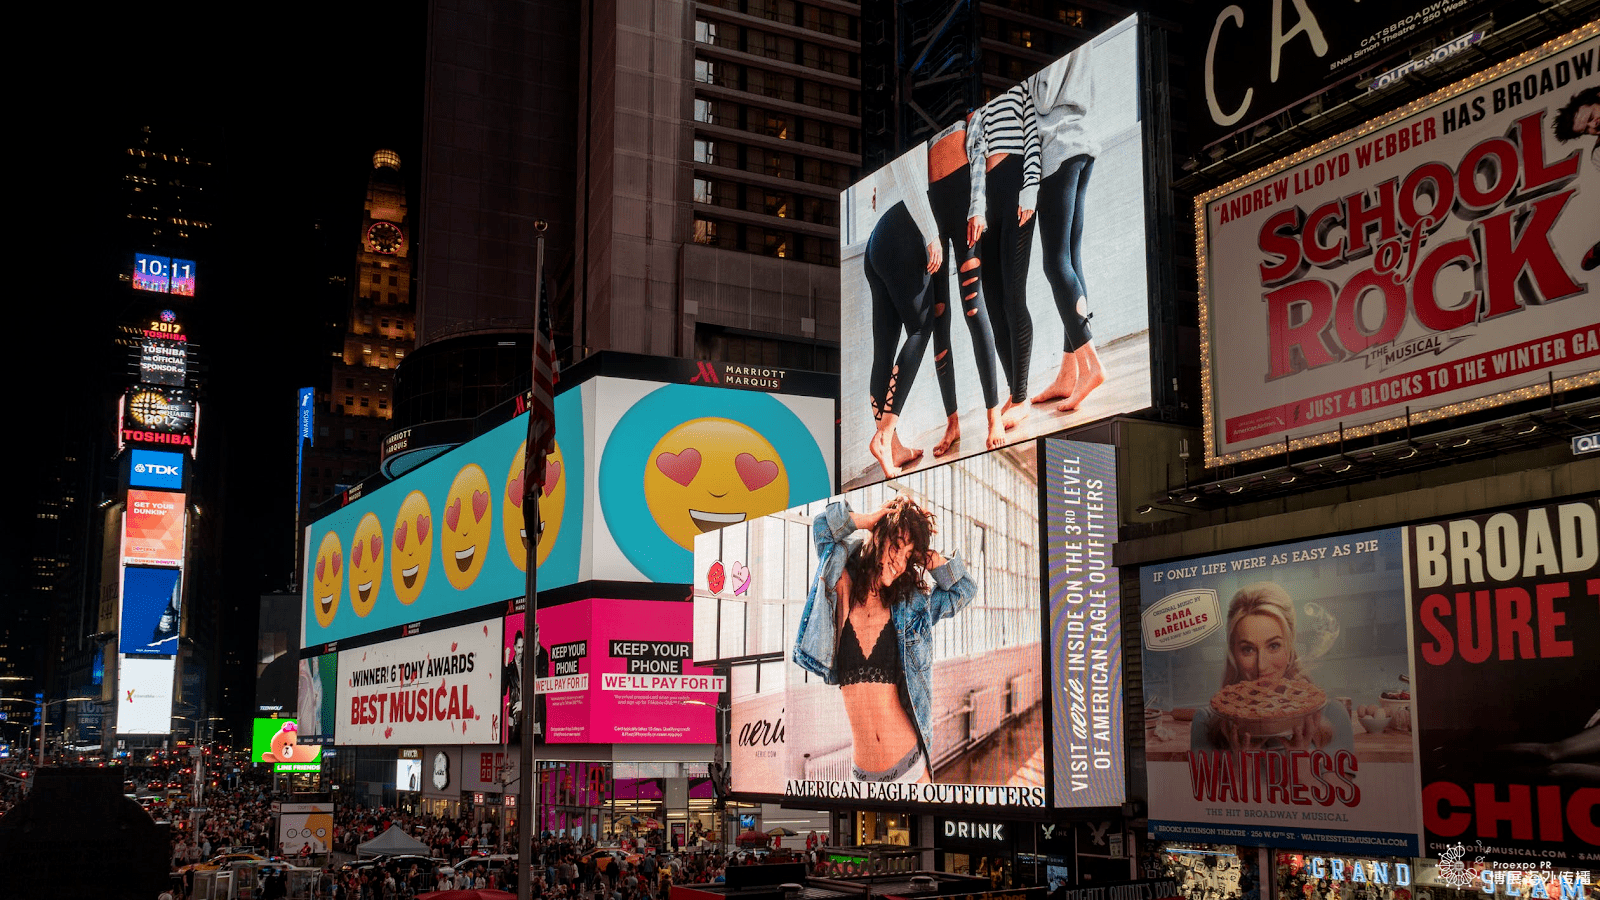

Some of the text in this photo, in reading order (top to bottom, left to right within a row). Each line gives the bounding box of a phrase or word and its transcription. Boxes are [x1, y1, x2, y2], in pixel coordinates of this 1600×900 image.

[1360, 0, 1453, 48] CATSBROADWA
[1336, 54, 1353, 68] Neil
[1354, 42, 1380, 59] Simon
[1381, 23, 1416, 44] Theatre
[1422, 10, 1441, 24] 250
[1205, 0, 1328, 126] CA
[1378, 32, 1474, 89] OUTFRONT
[1294, 151, 1350, 196] LLOYD
[1355, 116, 1437, 169] WEBBER
[1442, 94, 1486, 136] HAS
[1492, 47, 1600, 114] BROADW
[1258, 109, 1584, 288] SCHOOL
[1371, 214, 1436, 285] of
[138, 258, 191, 279] 10:11
[1262, 188, 1588, 383] ROCK
[143, 329, 187, 342] TOSHIBA
[151, 321, 181, 334] 2017
[142, 345, 186, 357] TOSHIBA
[152, 355, 185, 365] OFFICIAL
[1370, 346, 1388, 360] THE
[1385, 336, 1442, 365] MUSICAL
[142, 363, 177, 373] SPONSOR
[725, 365, 786, 379] MARRIOTT
[1305, 329, 1600, 421] JUST 4 BLOCKS TO THE WINTER GA
[725, 375, 779, 388] MARQUIS
[123, 429, 192, 446] TOSHIBA
[145, 463, 179, 476] TDK
[152, 502, 174, 510] YOUR
[1416, 501, 1600, 589] BROAD
[1153, 539, 1379, 583] IF ONLY LIFE WERE AS EASY AS PIE
[1152, 595, 1201, 617] ORIGINAL MUSIC BY
[1165, 607, 1192, 623] SARA
[1063, 456, 1089, 791] VISIT aerie INSIDE ON THE 3RD LEVEL
[1086, 478, 1111, 769] OF AMERICAN EAGLE OUTFITTERS
[1154, 613, 1208, 638] BAREILLES
[1420, 581, 1574, 666] SURE
[551, 643, 586, 660] KEEP YOUR
[613, 642, 689, 657] KEEP YOUR
[352, 652, 475, 688] WINNER! 6 TONY AWARDS
[556, 660, 578, 675] PHONE
[631, 660, 679, 673] PHONE
[535, 675, 588, 692] WE'LL PAY FOR IT
[605, 675, 725, 690] WE'LL PAY FOR IT
[351, 692, 388, 726] BEST
[738, 707, 785, 747] aeri
[1187, 749, 1361, 808] WAITRESS
[785, 779, 1044, 807] AMERICAN EAGLE OUTFITTERS
[1206, 807, 1349, 822] THE HIT BROADWAY MUSICAL
[944, 820, 1005, 841] DRINK
[1158, 825, 1182, 833] BROOKS
[1183, 826, 1216, 835] ATKINSON
[1216, 828, 1247, 837] THEATRE
[1251, 830, 1263, 838] 256
[1301, 833, 1408, 847] WAITRESSTHEMUSICAL.COM
[1312, 857, 1411, 887] GRAND
[1154, 880, 1178, 899] BBQ
[1480, 868, 1586, 900] SLAM
